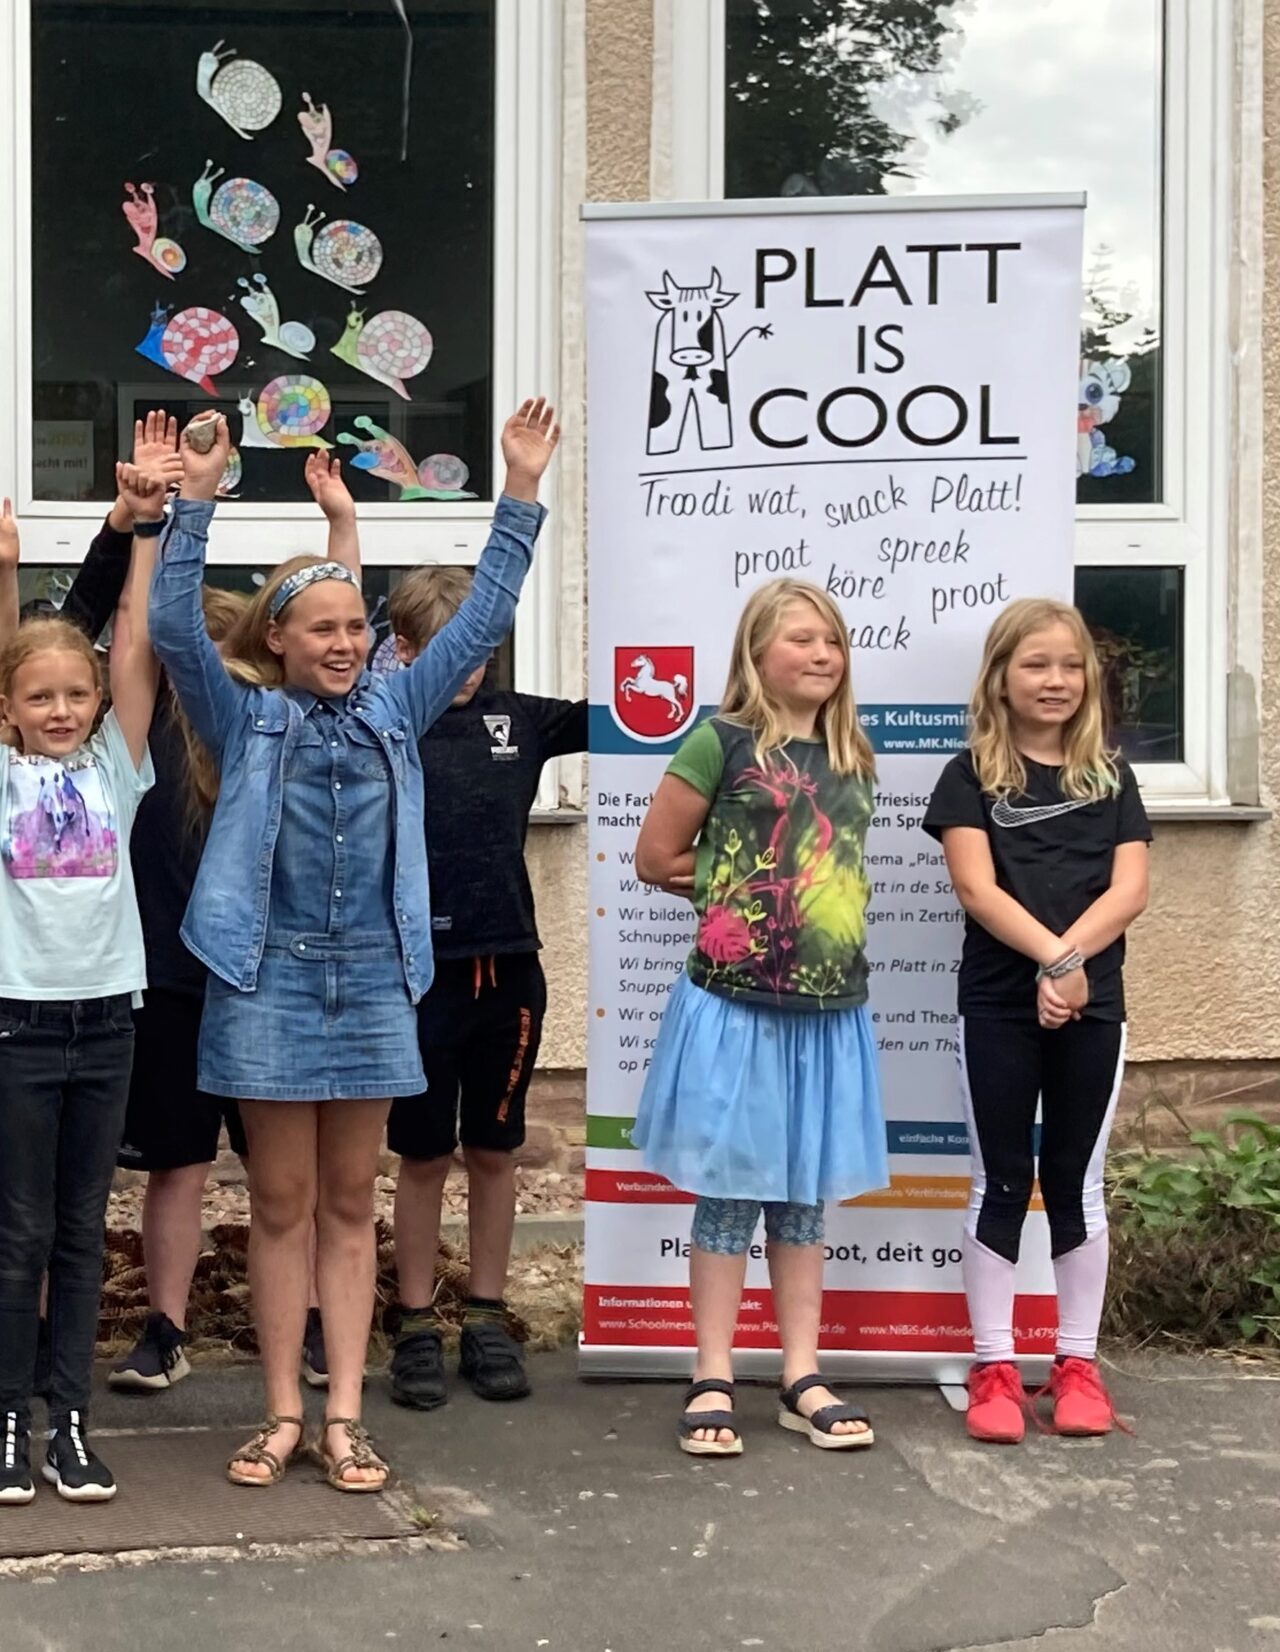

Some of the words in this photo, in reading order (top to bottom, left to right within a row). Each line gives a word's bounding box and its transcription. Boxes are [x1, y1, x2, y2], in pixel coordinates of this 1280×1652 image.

[754, 242, 1021, 309] PLATT
[857, 325, 905, 374] IS
[749, 384, 1020, 448] COOL
[748, 484, 807, 519] wat,
[825, 474, 908, 528] snack
[930, 472, 1023, 514] Platt!
[735, 539, 812, 588] proat
[877, 529, 970, 573] spreek
[826, 563, 887, 599] köre
[932, 572, 1011, 623] proot
[859, 713, 879, 726] es
[885, 710, 975, 727] Kultusmin
[598, 792, 620, 807] Die
[598, 813, 641, 827] macht
[869, 816, 891, 828] en
[897, 814, 923, 831] Spr
[620, 880, 639, 892] Wi
[874, 882, 886, 893] tt
[891, 881, 905, 893] in
[910, 881, 929, 894] de
[619, 908, 646, 921] Wir
[650, 907, 695, 922] bilden
[866, 911, 895, 924] gen
[901, 909, 914, 922] in
[619, 930, 696, 947] Schnupper
[619, 958, 639, 970] Wi
[869, 961, 885, 972] en
[890, 959, 927, 973] Platt
[932, 960, 946, 972] in
[619, 979, 673, 996] Snuppe
[619, 1008, 643, 1021] Wir
[886, 1011, 915, 1023] und
[619, 1036, 639, 1048] Wi
[909, 1040, 929, 1051] un
[619, 1061, 638, 1073] op
[660, 1239, 690, 1257] Pla
[876, 1242, 924, 1263] deit
[932, 1246, 963, 1268] go
